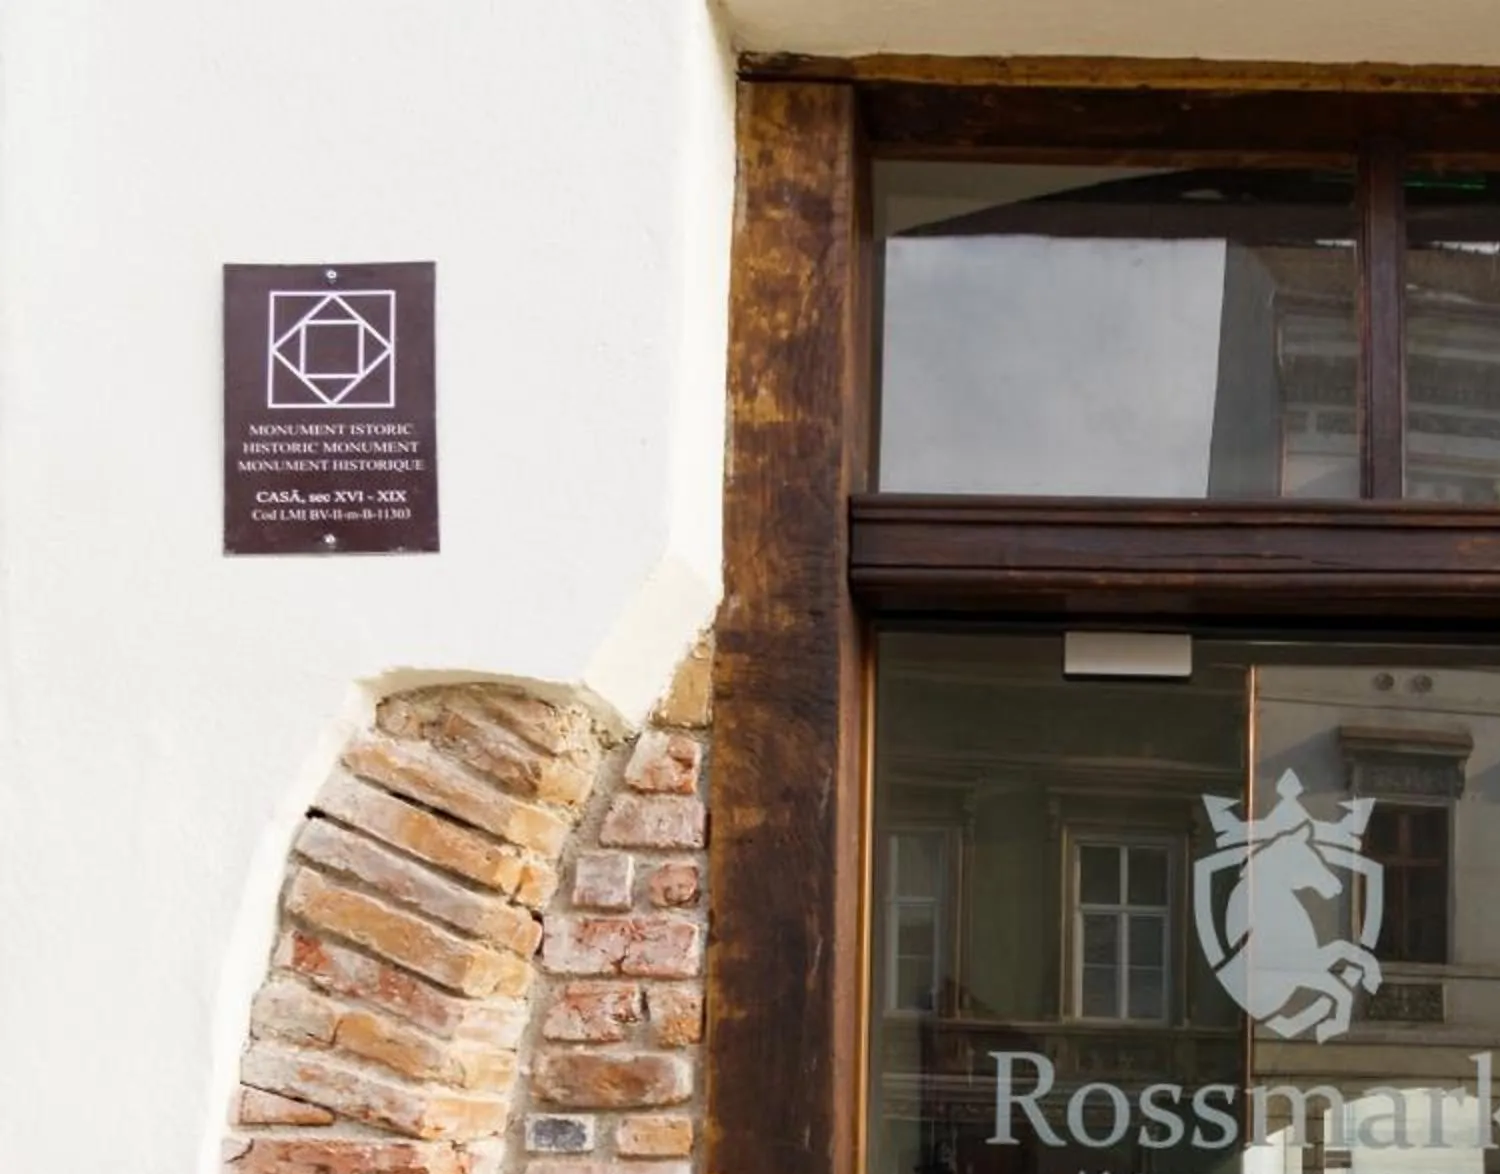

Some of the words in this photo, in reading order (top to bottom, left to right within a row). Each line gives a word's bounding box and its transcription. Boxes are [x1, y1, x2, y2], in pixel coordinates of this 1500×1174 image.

[249, 424, 344, 436] MONUMENT
[350, 424, 413, 436] ISTORIC
[243, 442, 319, 454] HISTORIC
[323, 441, 420, 453] MONUMENT
[238, 460, 328, 471] MONUMENT
[332, 460, 425, 473] HISTORIQUE
[308, 494, 330, 503] sec
[334, 491, 363, 503] XVI
[377, 490, 407, 502] XIX
[251, 509, 276, 521] Cod
[280, 509, 307, 521] LMI
